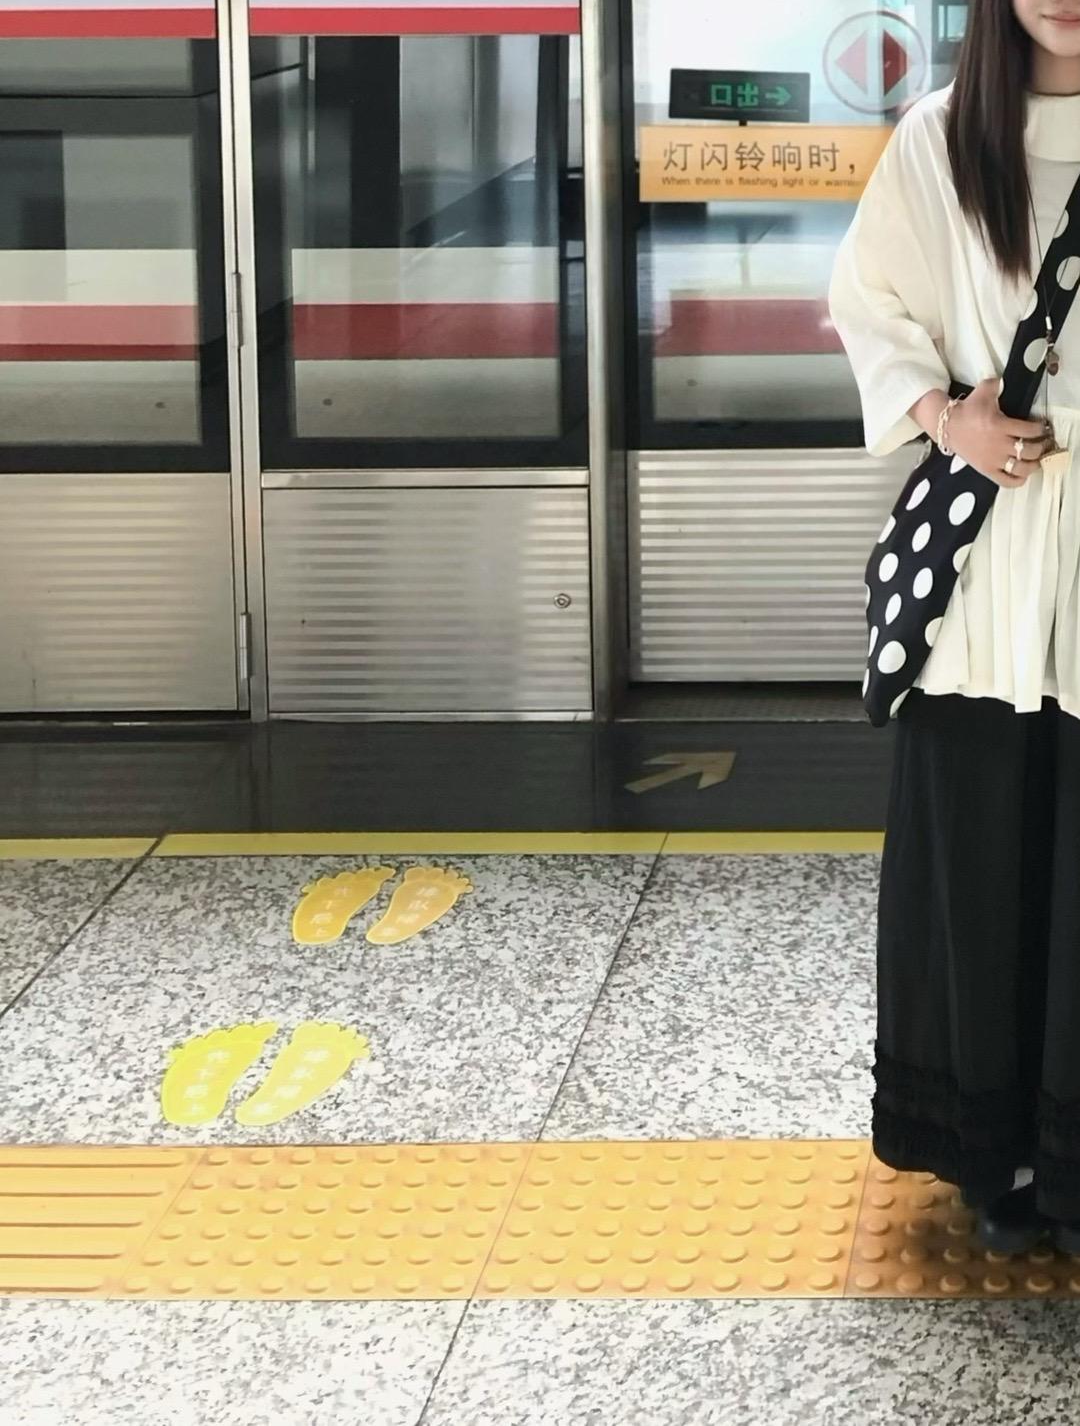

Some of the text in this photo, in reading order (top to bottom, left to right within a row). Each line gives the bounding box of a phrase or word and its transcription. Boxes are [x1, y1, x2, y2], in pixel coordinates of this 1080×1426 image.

[661, 176, 690, 186] When
[695, 176, 721, 186] there
[725, 176, 734, 186] is
[738, 176, 778, 189] flashing
[782, 176, 804, 188] light
[809, 177, 819, 186] or
